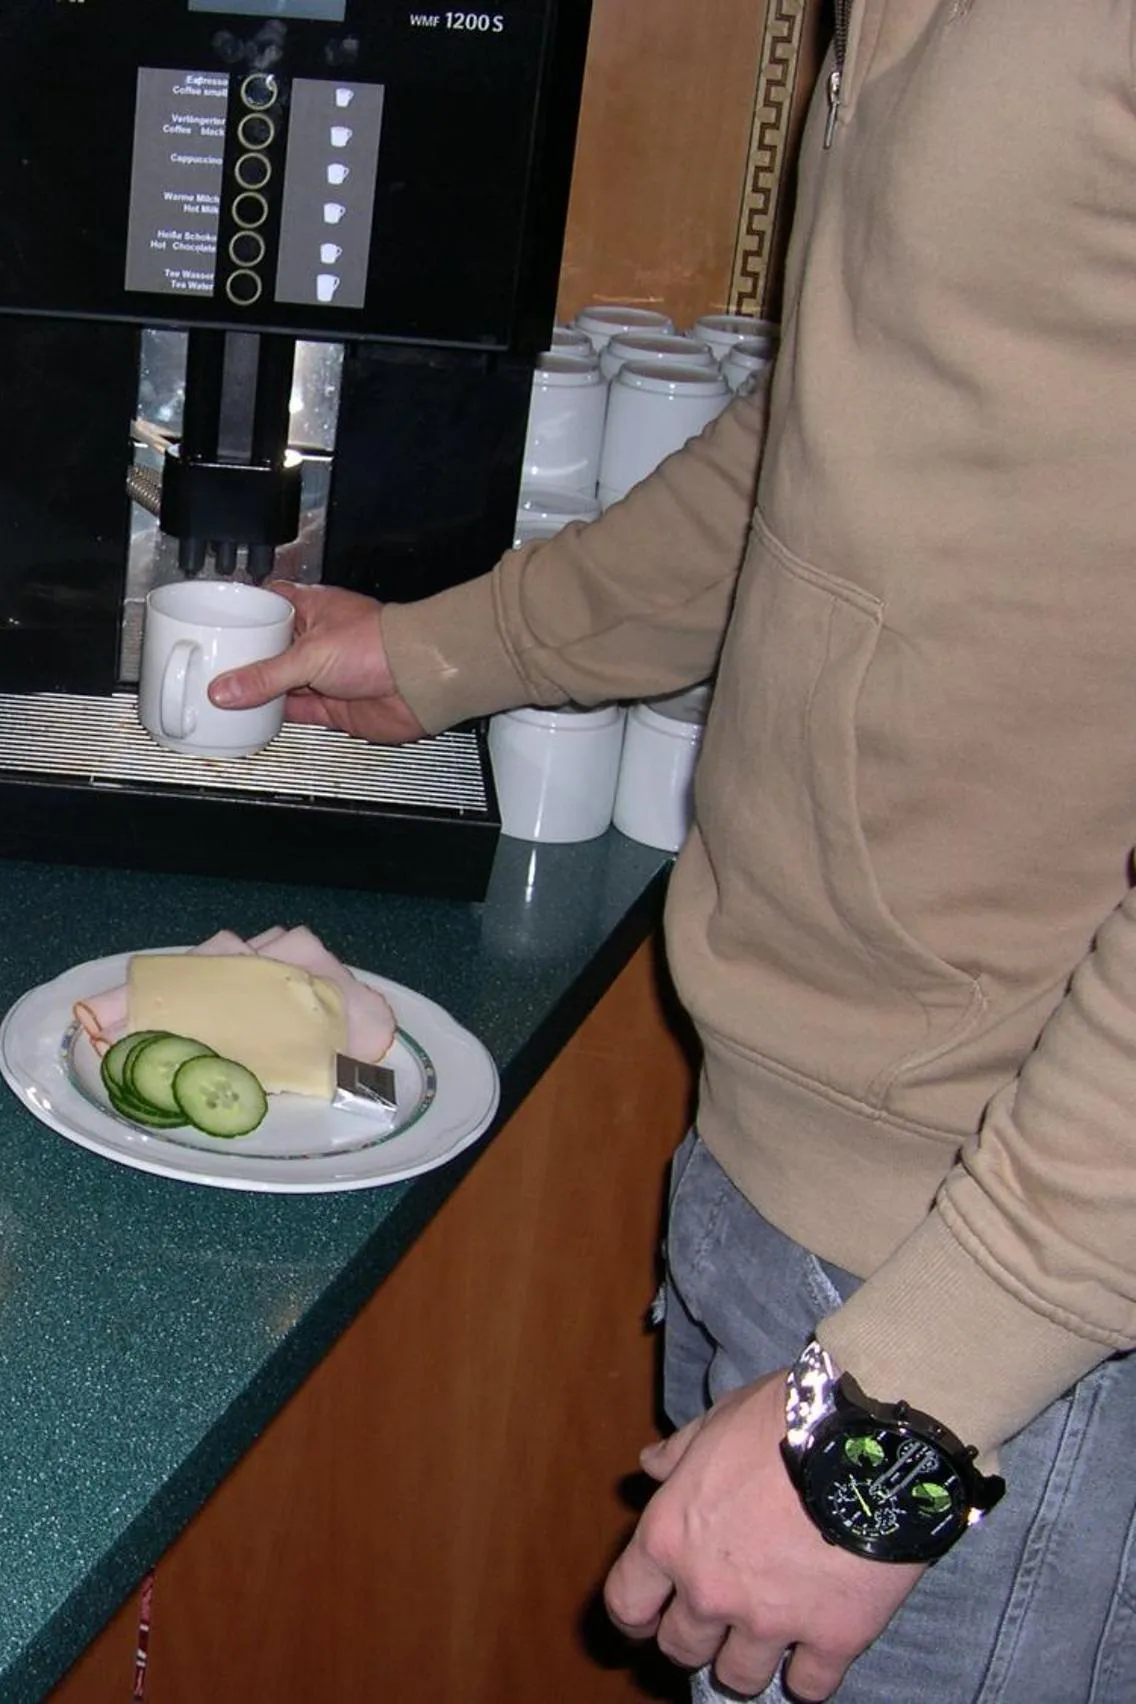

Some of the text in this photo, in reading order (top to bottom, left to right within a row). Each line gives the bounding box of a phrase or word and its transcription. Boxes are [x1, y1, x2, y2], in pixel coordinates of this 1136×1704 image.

[409, 13, 440, 27] WMF
[172, 85, 202, 95] Coffee
[162, 124, 225, 137] Coffee black
[170, 153, 223, 165] Cappuccino
[163, 192, 220, 204] Warme Milch
[183, 203, 219, 214] Hot Milk
[150, 240, 216, 253] Hot Chocolate
[171, 279, 214, 291] Tea Water
